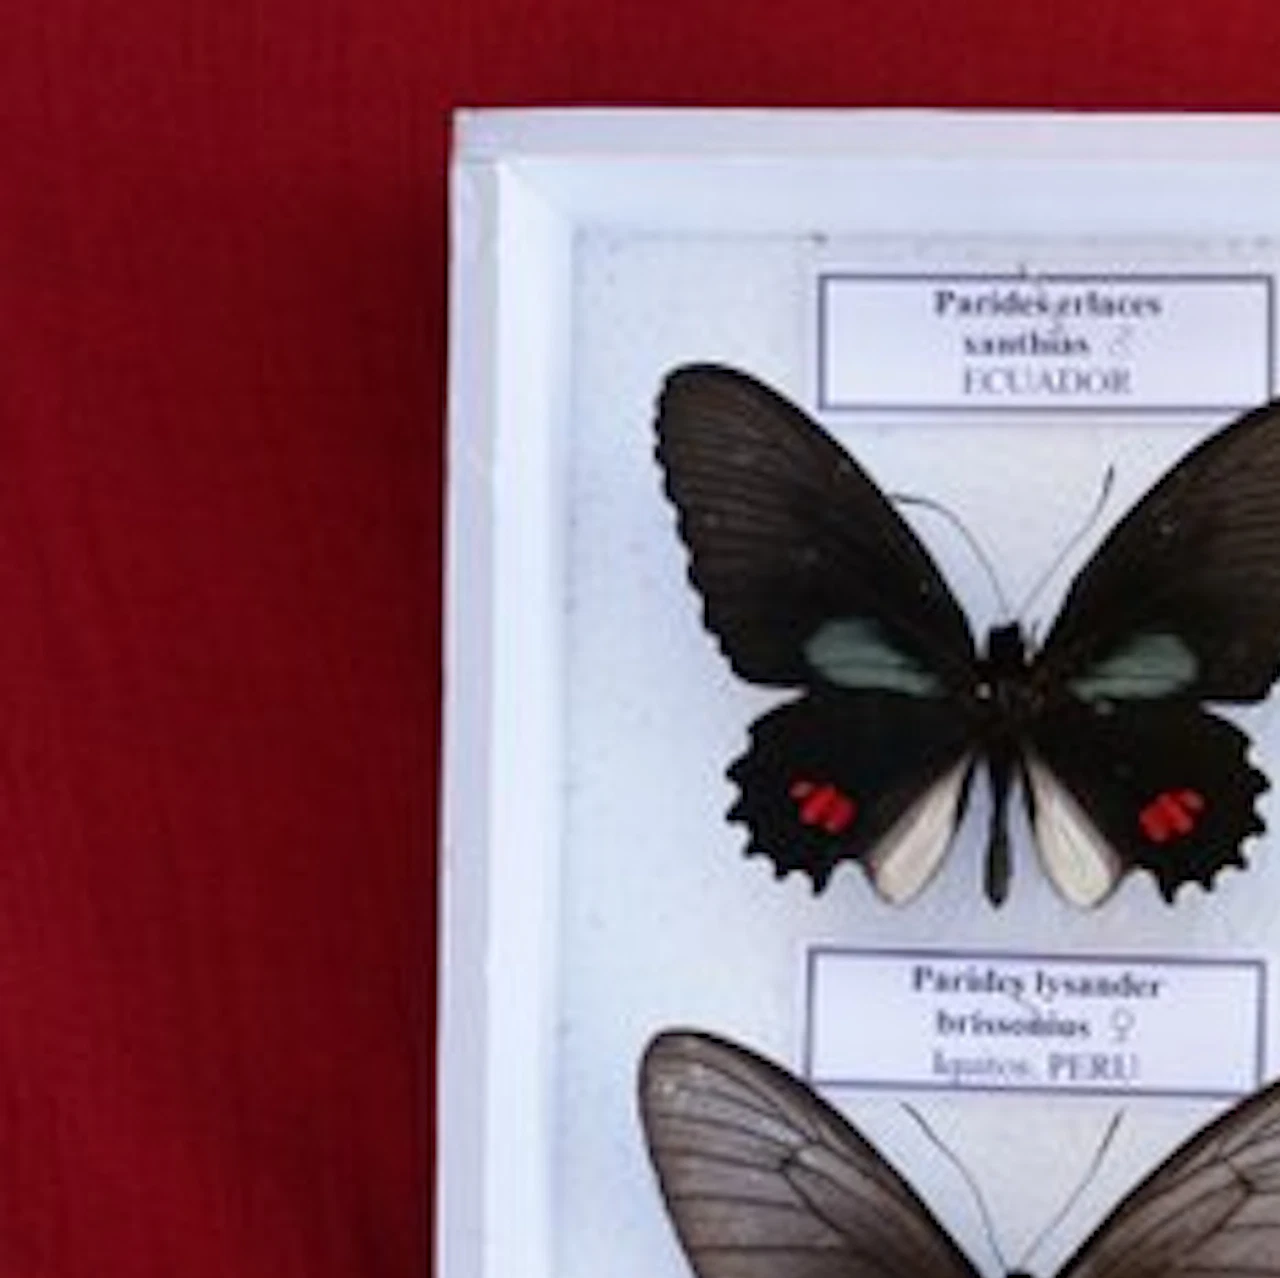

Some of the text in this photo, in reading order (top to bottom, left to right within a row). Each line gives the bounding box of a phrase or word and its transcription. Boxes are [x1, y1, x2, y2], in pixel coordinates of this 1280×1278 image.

[934, 290, 1047, 317] Parides
[964, 368, 1132, 396] ECUADOR
[1035, 967, 1161, 1001] lysander
[1048, 1052, 1139, 1080] PERU
